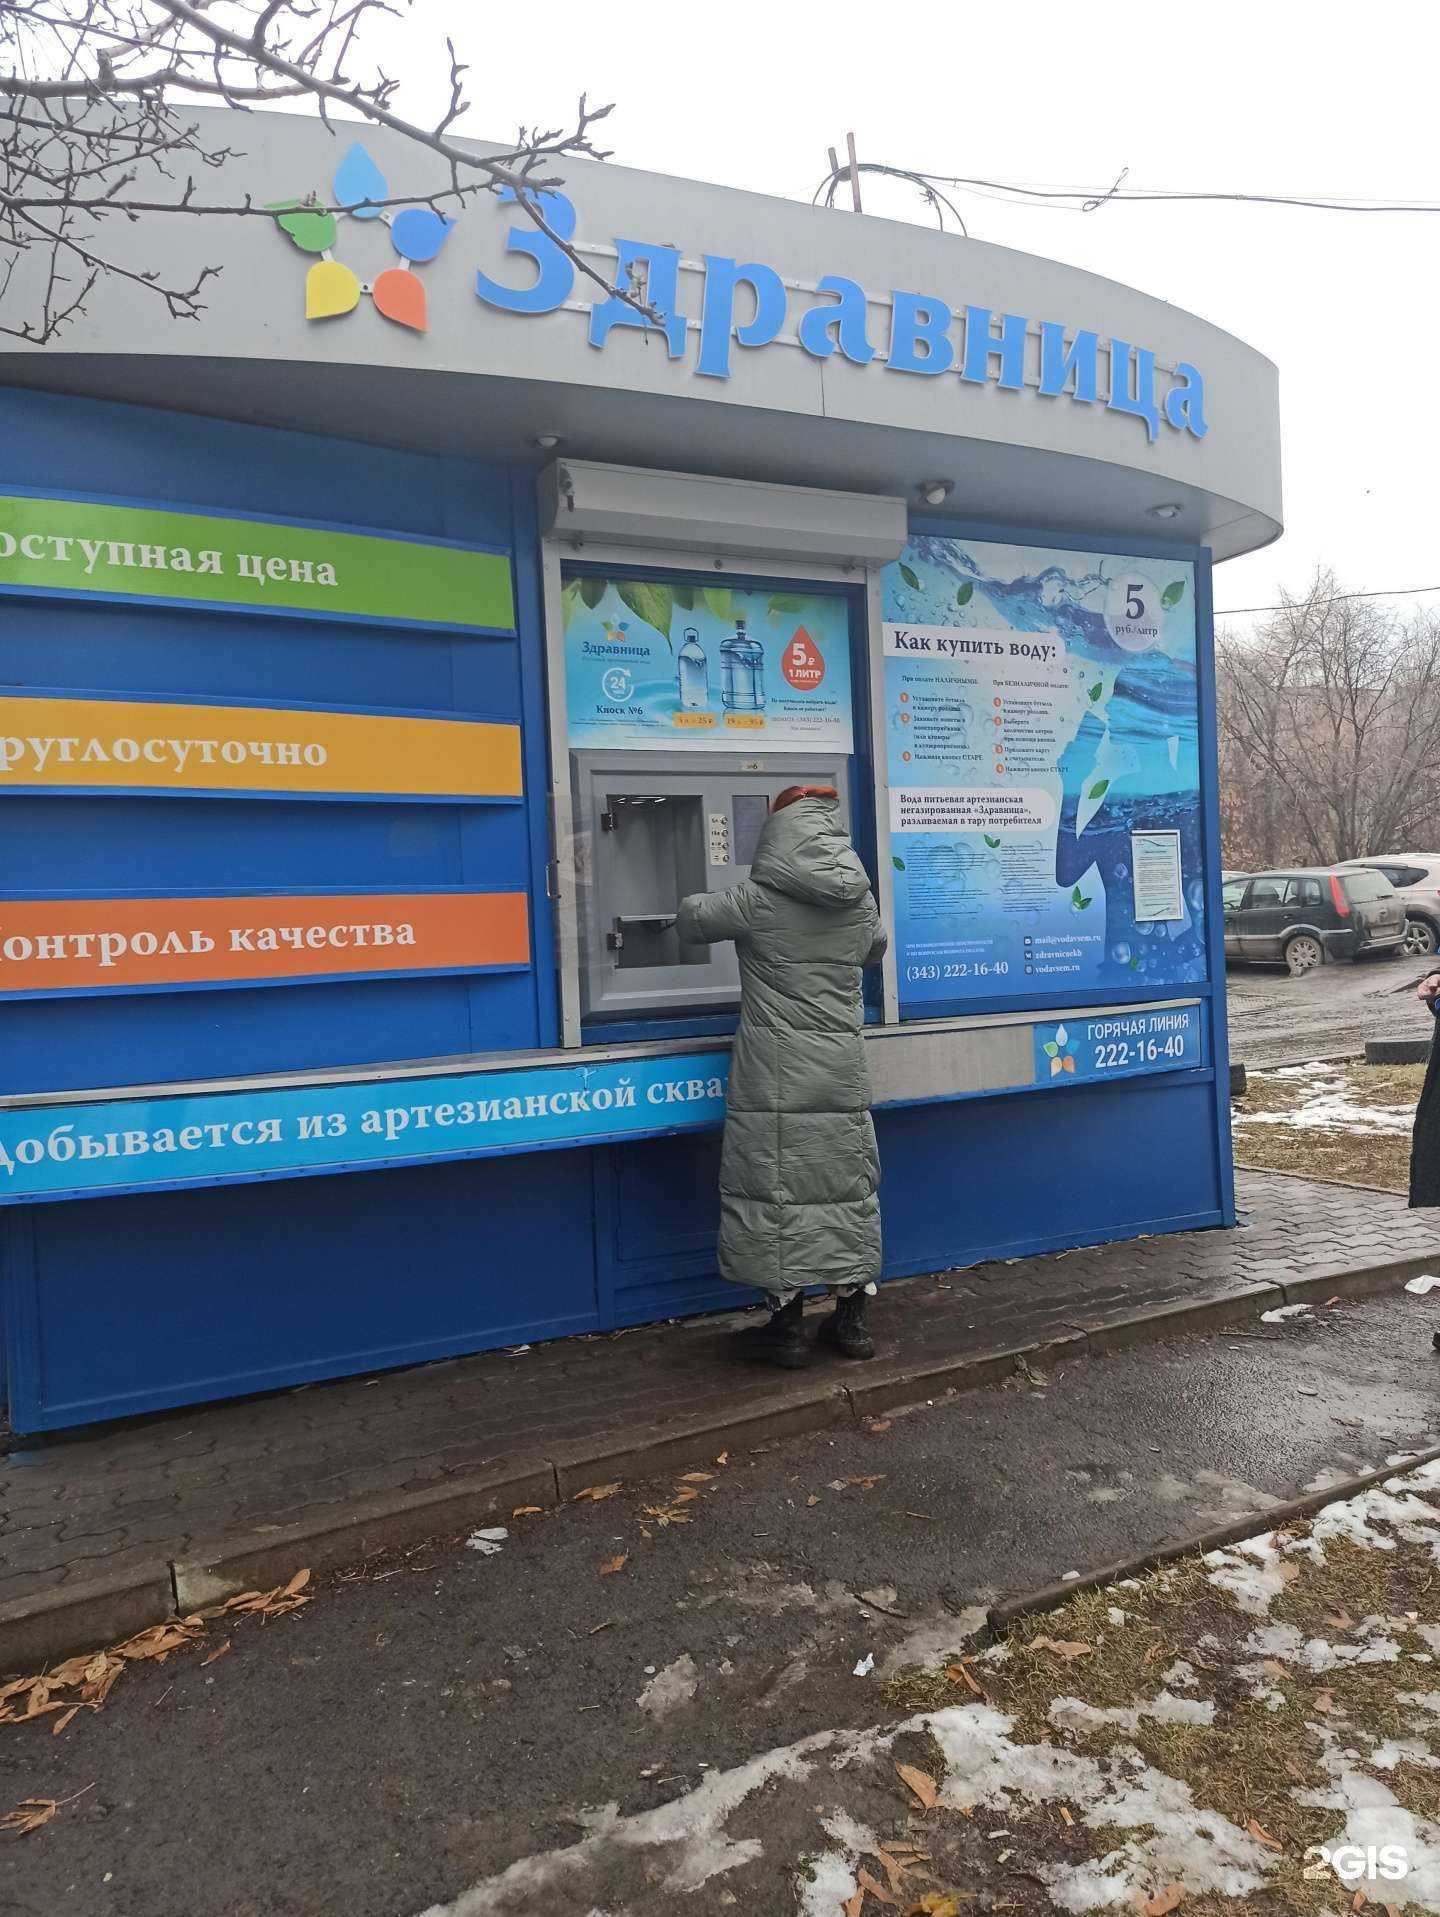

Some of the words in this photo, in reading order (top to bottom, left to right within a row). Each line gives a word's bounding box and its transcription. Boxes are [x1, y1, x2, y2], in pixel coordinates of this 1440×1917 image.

[475, 185, 1208, 443] Здравница
[236, 555, 339, 587] цена
[1126, 584, 1145, 620] 5
[581, 641, 651, 657] Здравница
[893, 630, 931, 651] Как
[936, 638, 1004, 658] купить
[1009, 643, 1057, 662] воду:
[596, 704, 626, 715] Киоск
[0, 736, 328, 773] руглосуточно
[900, 795, 922, 804] Вода
[923, 796, 965, 804] питьевая
[966, 796, 1024, 806] артезианская
[900, 806, 972, 816] негазированная
[901, 817, 958, 827] разливаемая
[967, 818, 987, 828] тару
[988, 816, 1042, 827] потребителя
[0, 925, 216, 967] онтроль
[228, 922, 417, 953] качества
[906, 964, 941, 983] (343)
[943, 962, 1009, 978] 222-16-40
[1035, 964, 1081, 974] vodavsem.ru
[1087, 1019, 1146, 1041] ГОРЯЧАЯ
[1148, 1013, 1190, 1033] ЛИНИЯ
[1095, 1035, 1184, 1069] 222-16-40
[297, 1112, 347, 1140] из
[361, 1077, 638, 1141] артезианской
[646, 1077, 729, 1105] сква
